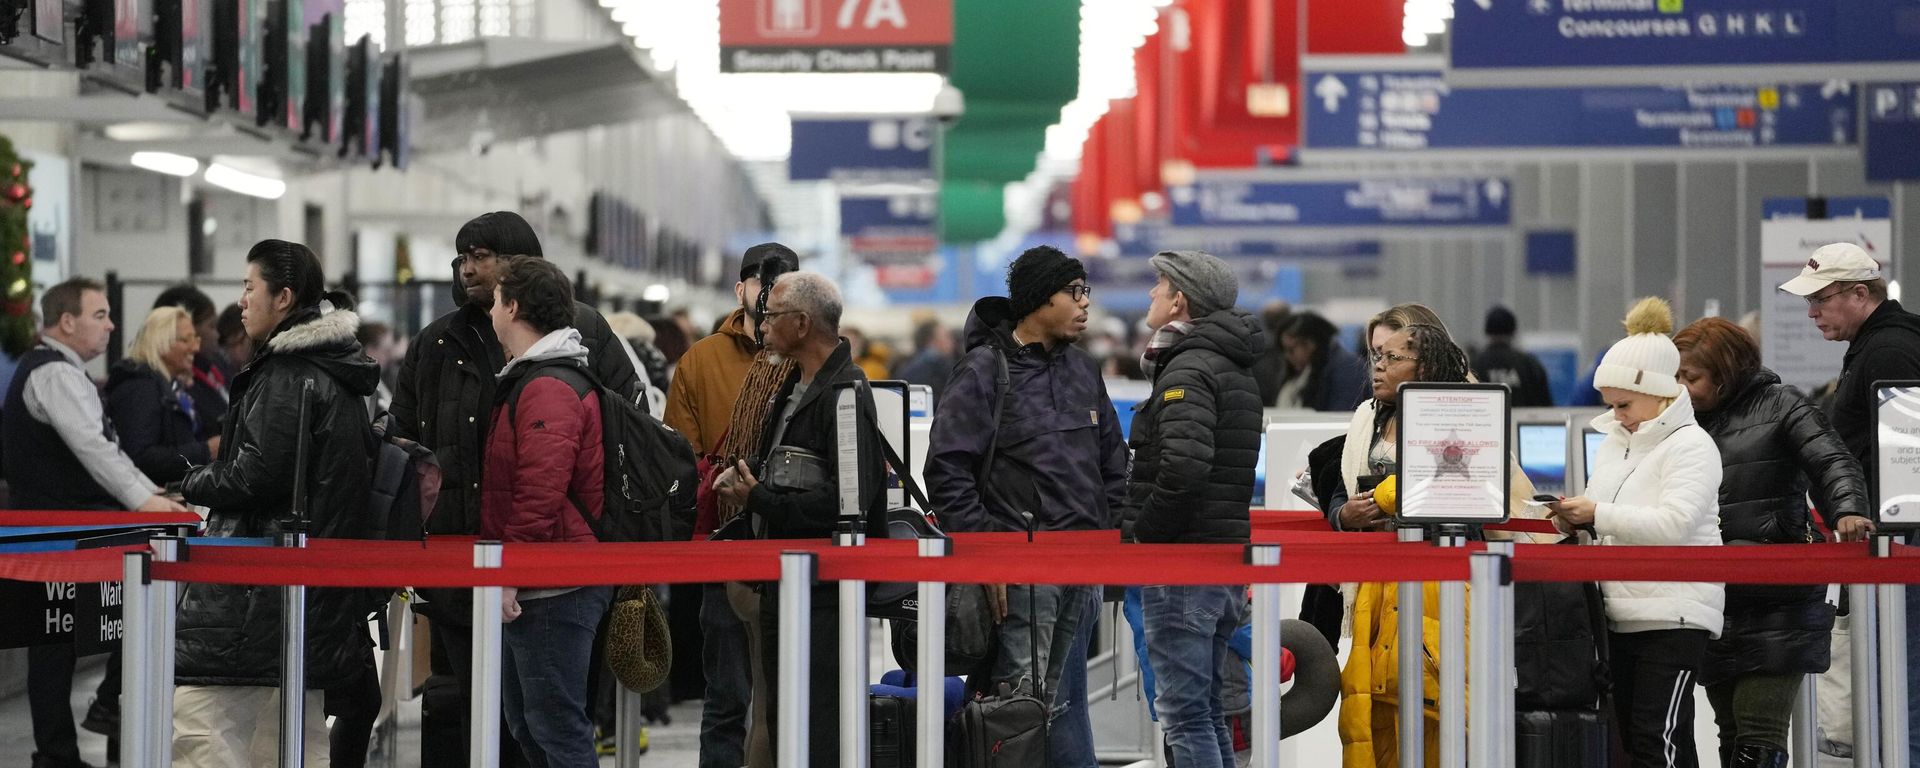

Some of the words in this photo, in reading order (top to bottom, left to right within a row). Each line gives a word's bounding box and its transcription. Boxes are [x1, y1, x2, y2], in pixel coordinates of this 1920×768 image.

[1558, 16, 1691, 38] Concourses
[1698, 14, 1717, 36] G
[1726, 14, 1745, 34] H
[1754, 14, 1773, 34] K
[1783, 13, 1800, 34] L
[732, 50, 813, 71] Security
[816, 50, 879, 69] Check
[882, 49, 935, 69] Point
[1875, 88, 1898, 118] P
[1467, 440, 1499, 448] ALLOWED
[46, 582, 75, 601] Wa
[100, 581, 122, 607] Wait
[45, 608, 74, 634] He
[100, 614, 123, 642] Here
